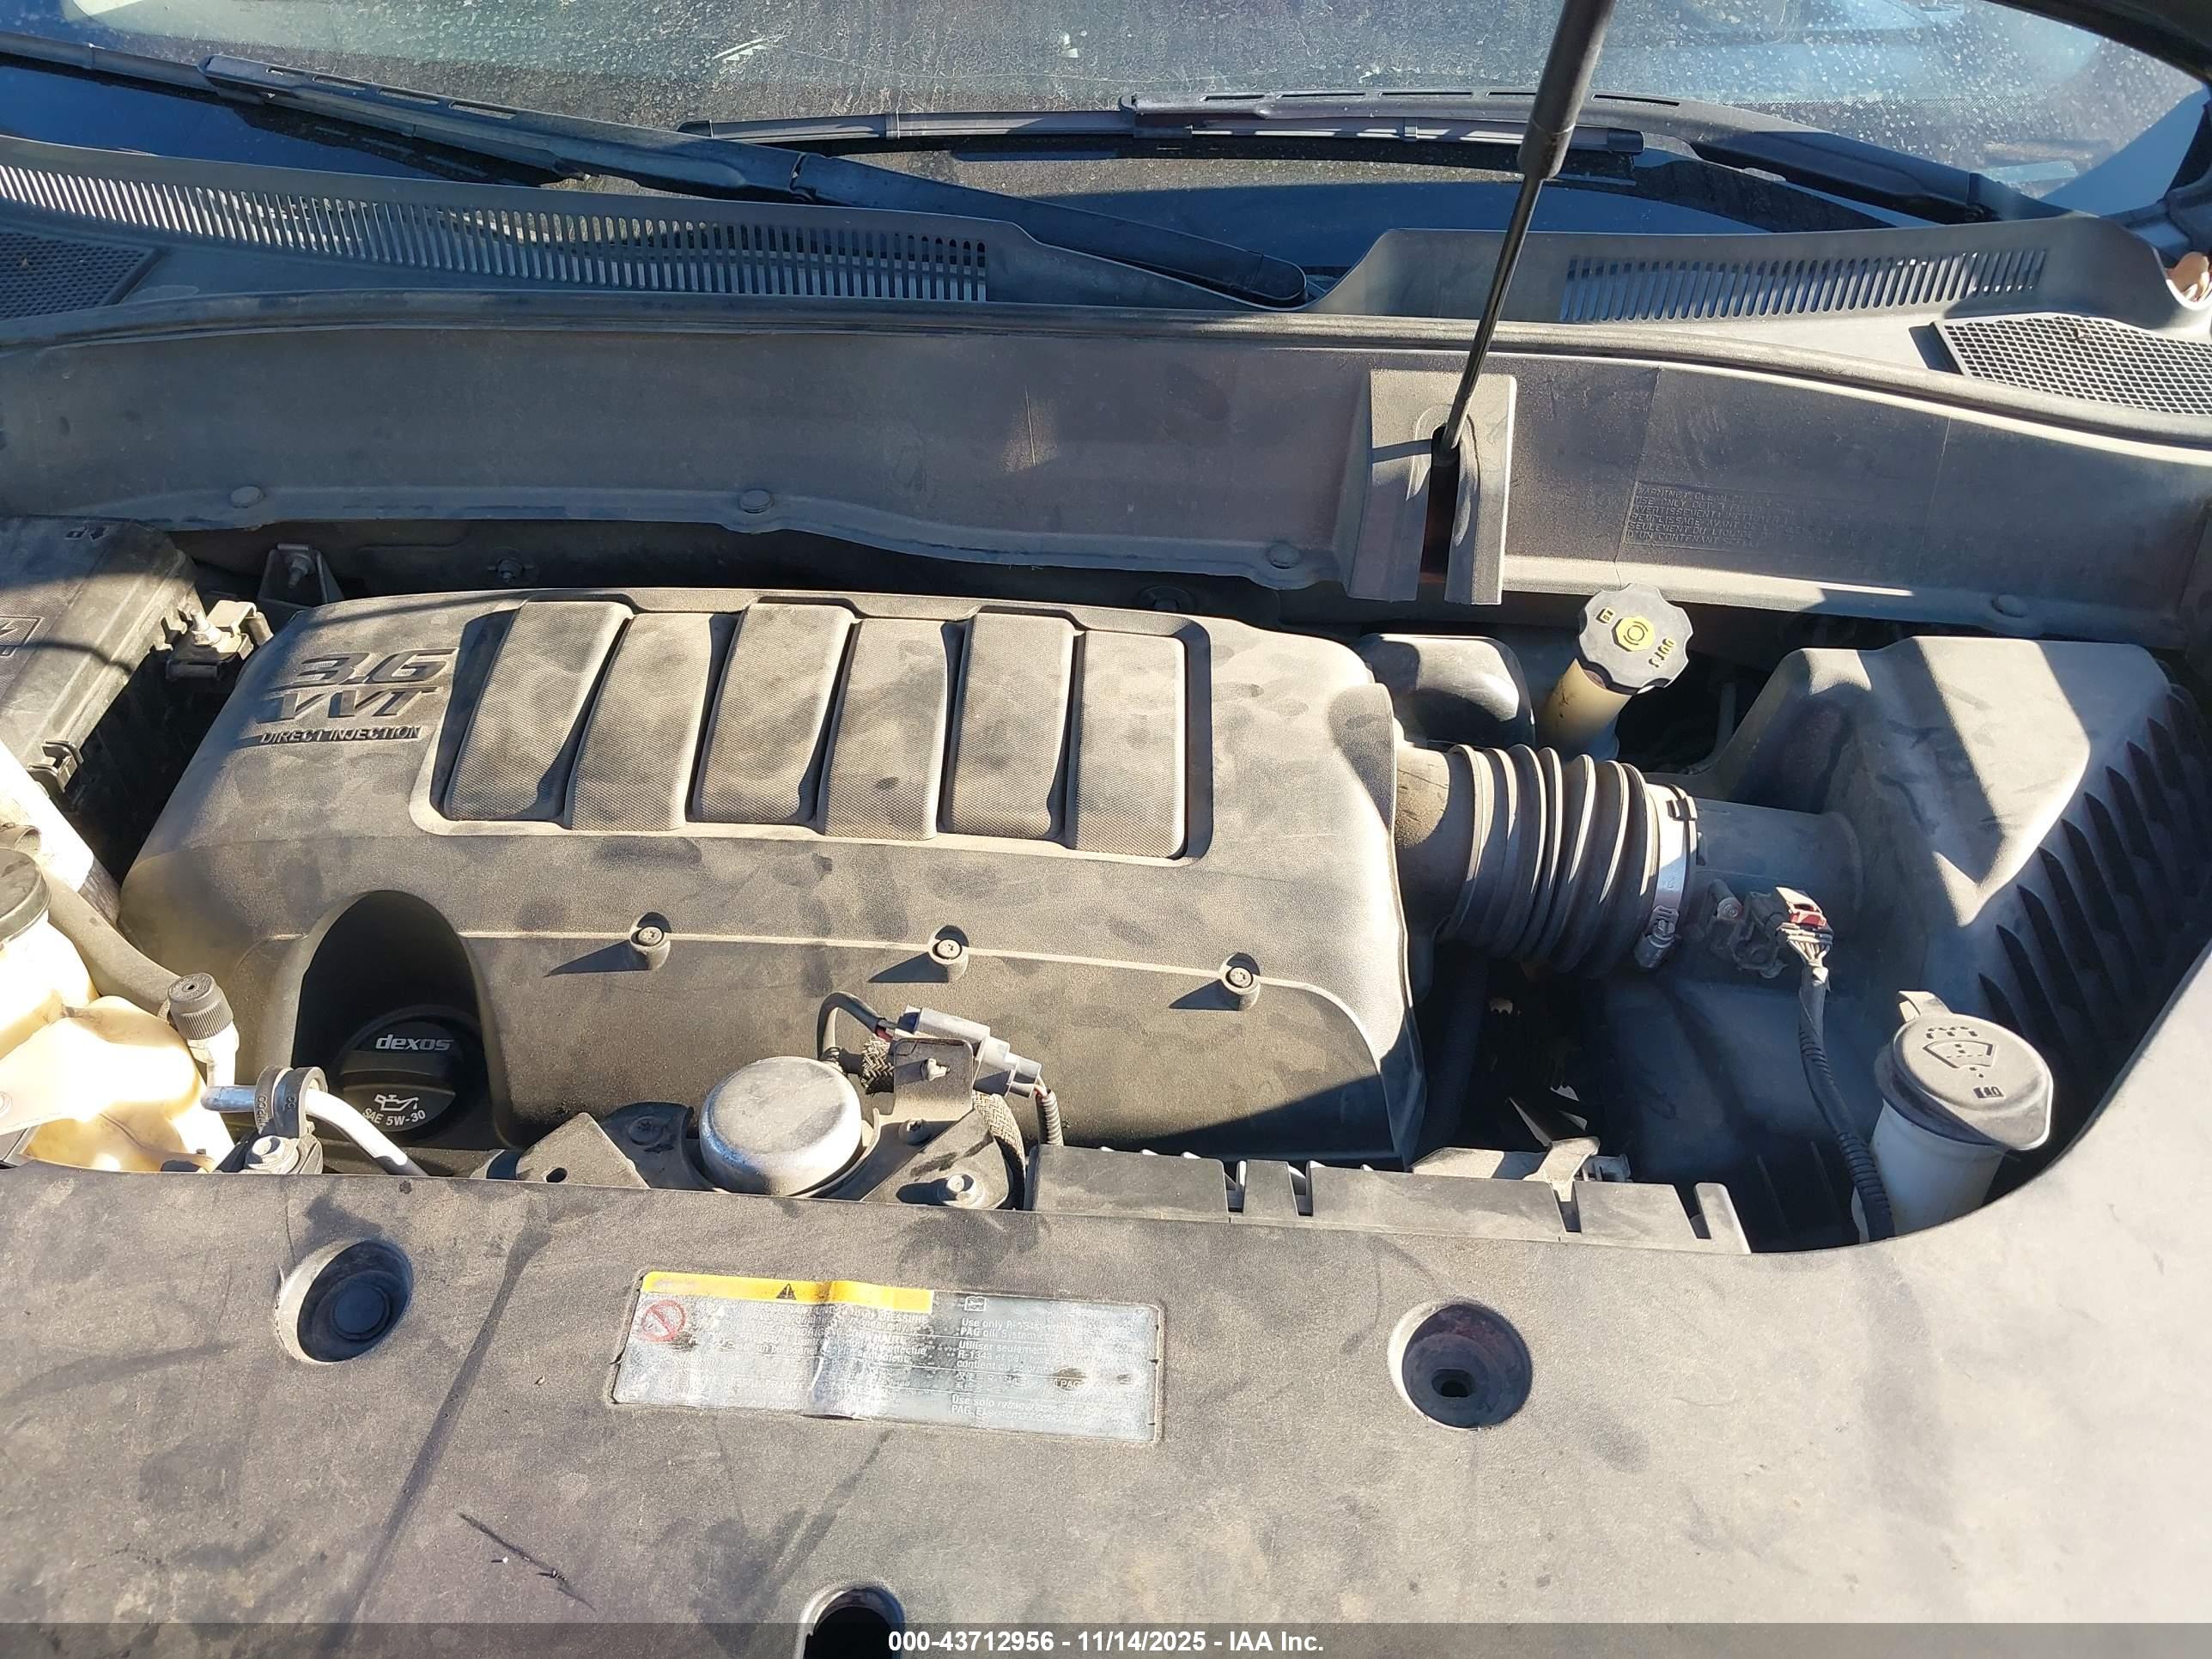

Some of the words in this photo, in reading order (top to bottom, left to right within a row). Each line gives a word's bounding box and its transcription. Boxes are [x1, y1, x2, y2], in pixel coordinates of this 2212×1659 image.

[255, 685, 439, 725] VVT
[259, 728, 326, 744] DIRECT
[329, 725, 422, 744] INJECTION
[375, 1034, 454, 1051] dexos
[362, 1107, 385, 1126] SAE
[385, 1109, 427, 1127] 5W-30
[961, 1317, 980, 1327] Use
[983, 1320, 1003, 1329] only
[960, 1326, 980, 1336] PAG
[958, 1340, 993, 1351] Utiliser
[957, 1349, 993, 1360] R-134a
[951, 1394, 970, 1404] Use
